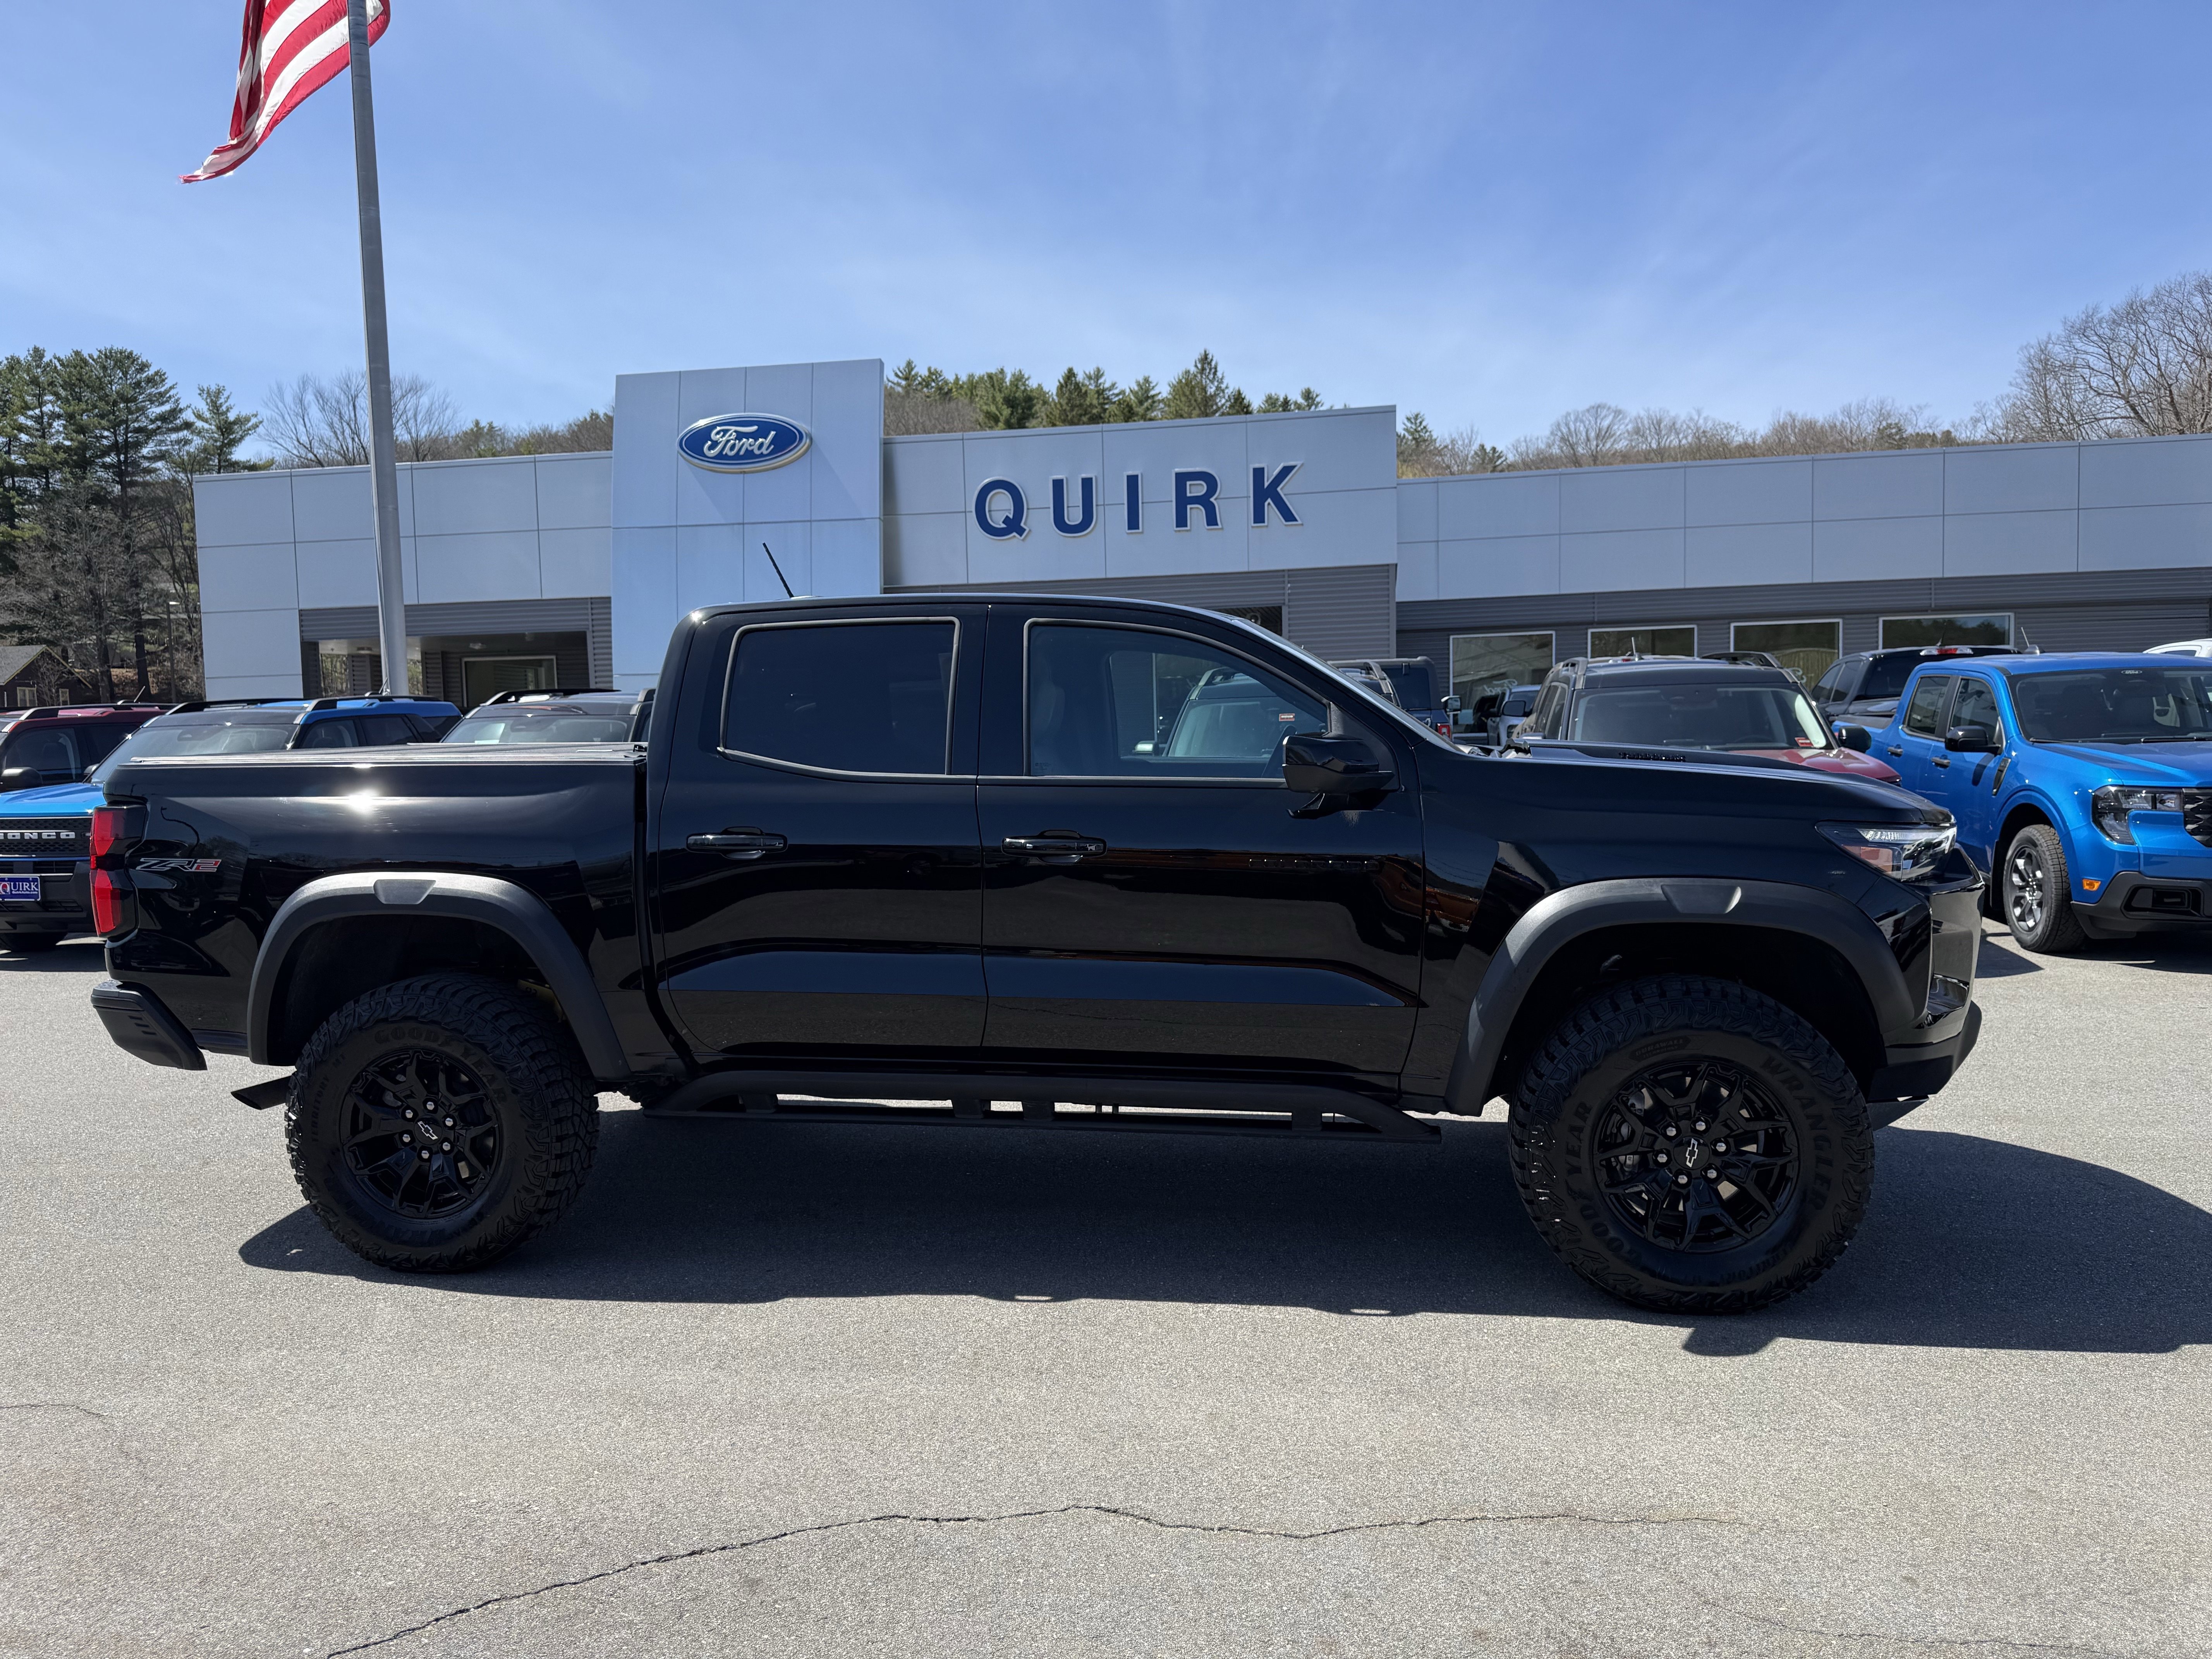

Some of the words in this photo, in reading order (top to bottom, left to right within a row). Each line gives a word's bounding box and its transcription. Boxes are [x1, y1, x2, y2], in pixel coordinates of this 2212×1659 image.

[703, 425, 776, 457] Ford
[972, 461, 1304, 540] QUIRK
[136, 858, 222, 872] ZR2
[0, 882, 38, 894] QUIRK
[1760, 1055, 1833, 1210] WRANGLER
